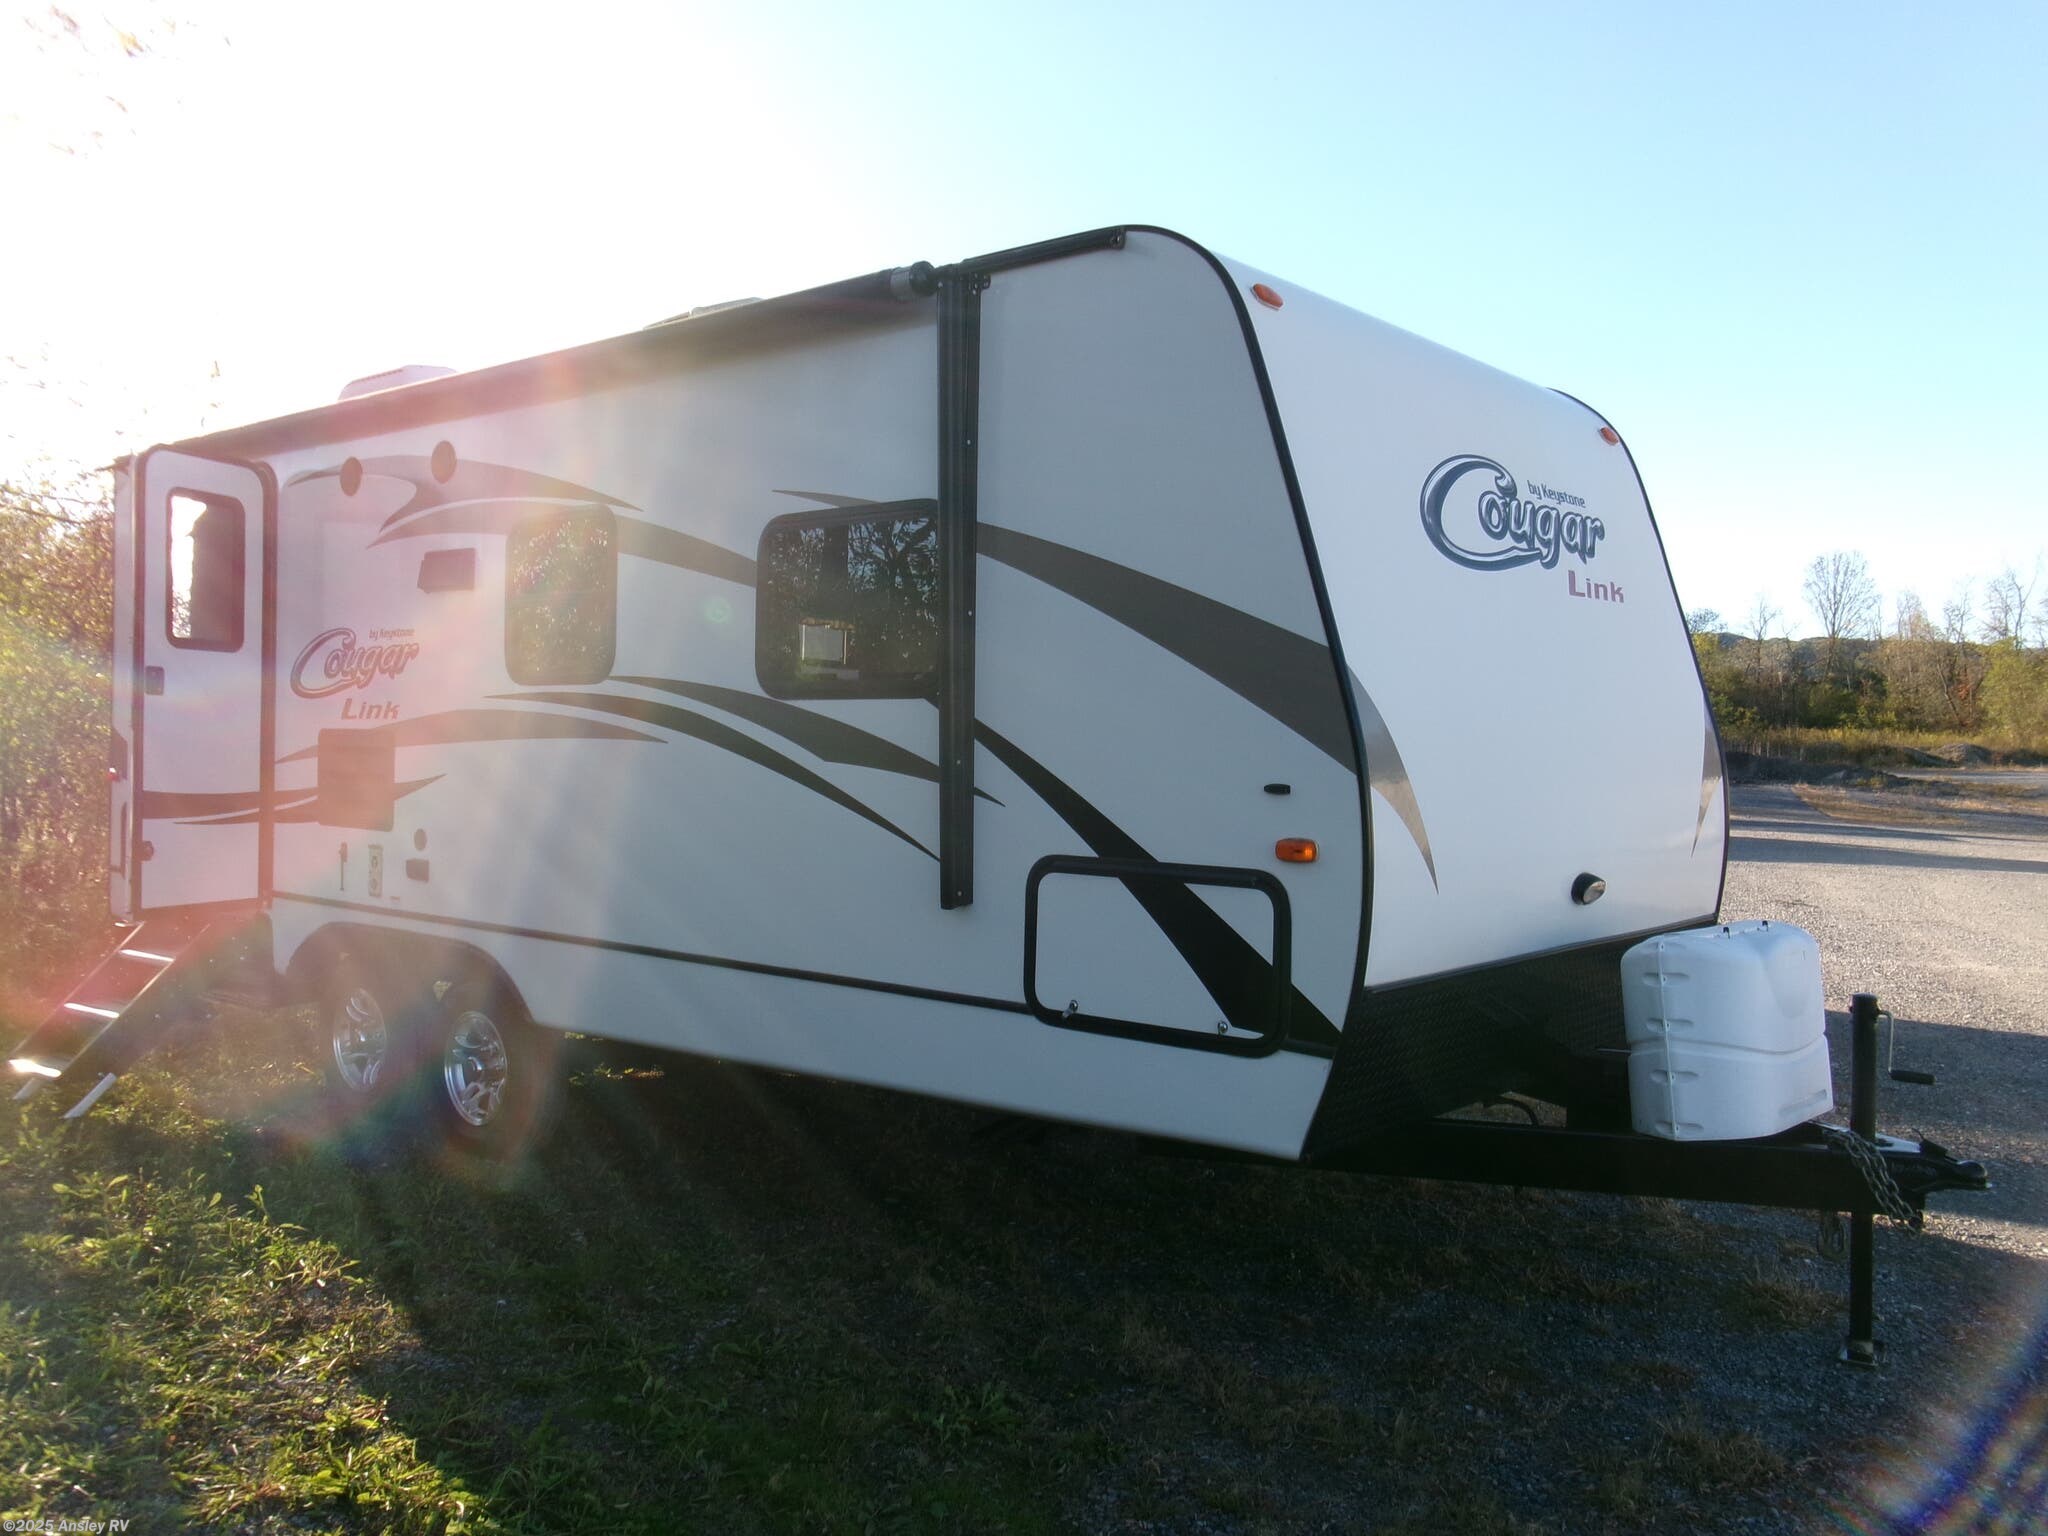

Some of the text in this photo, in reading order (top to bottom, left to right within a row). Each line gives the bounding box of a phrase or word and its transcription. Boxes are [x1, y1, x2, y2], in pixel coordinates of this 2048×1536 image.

[1527, 480, 1586, 509] by Keystone
[1420, 454, 1605, 571] Cougar
[1568, 570, 1625, 604] Link
[290, 627, 420, 699] Cougar
[341, 698, 400, 720] Link
